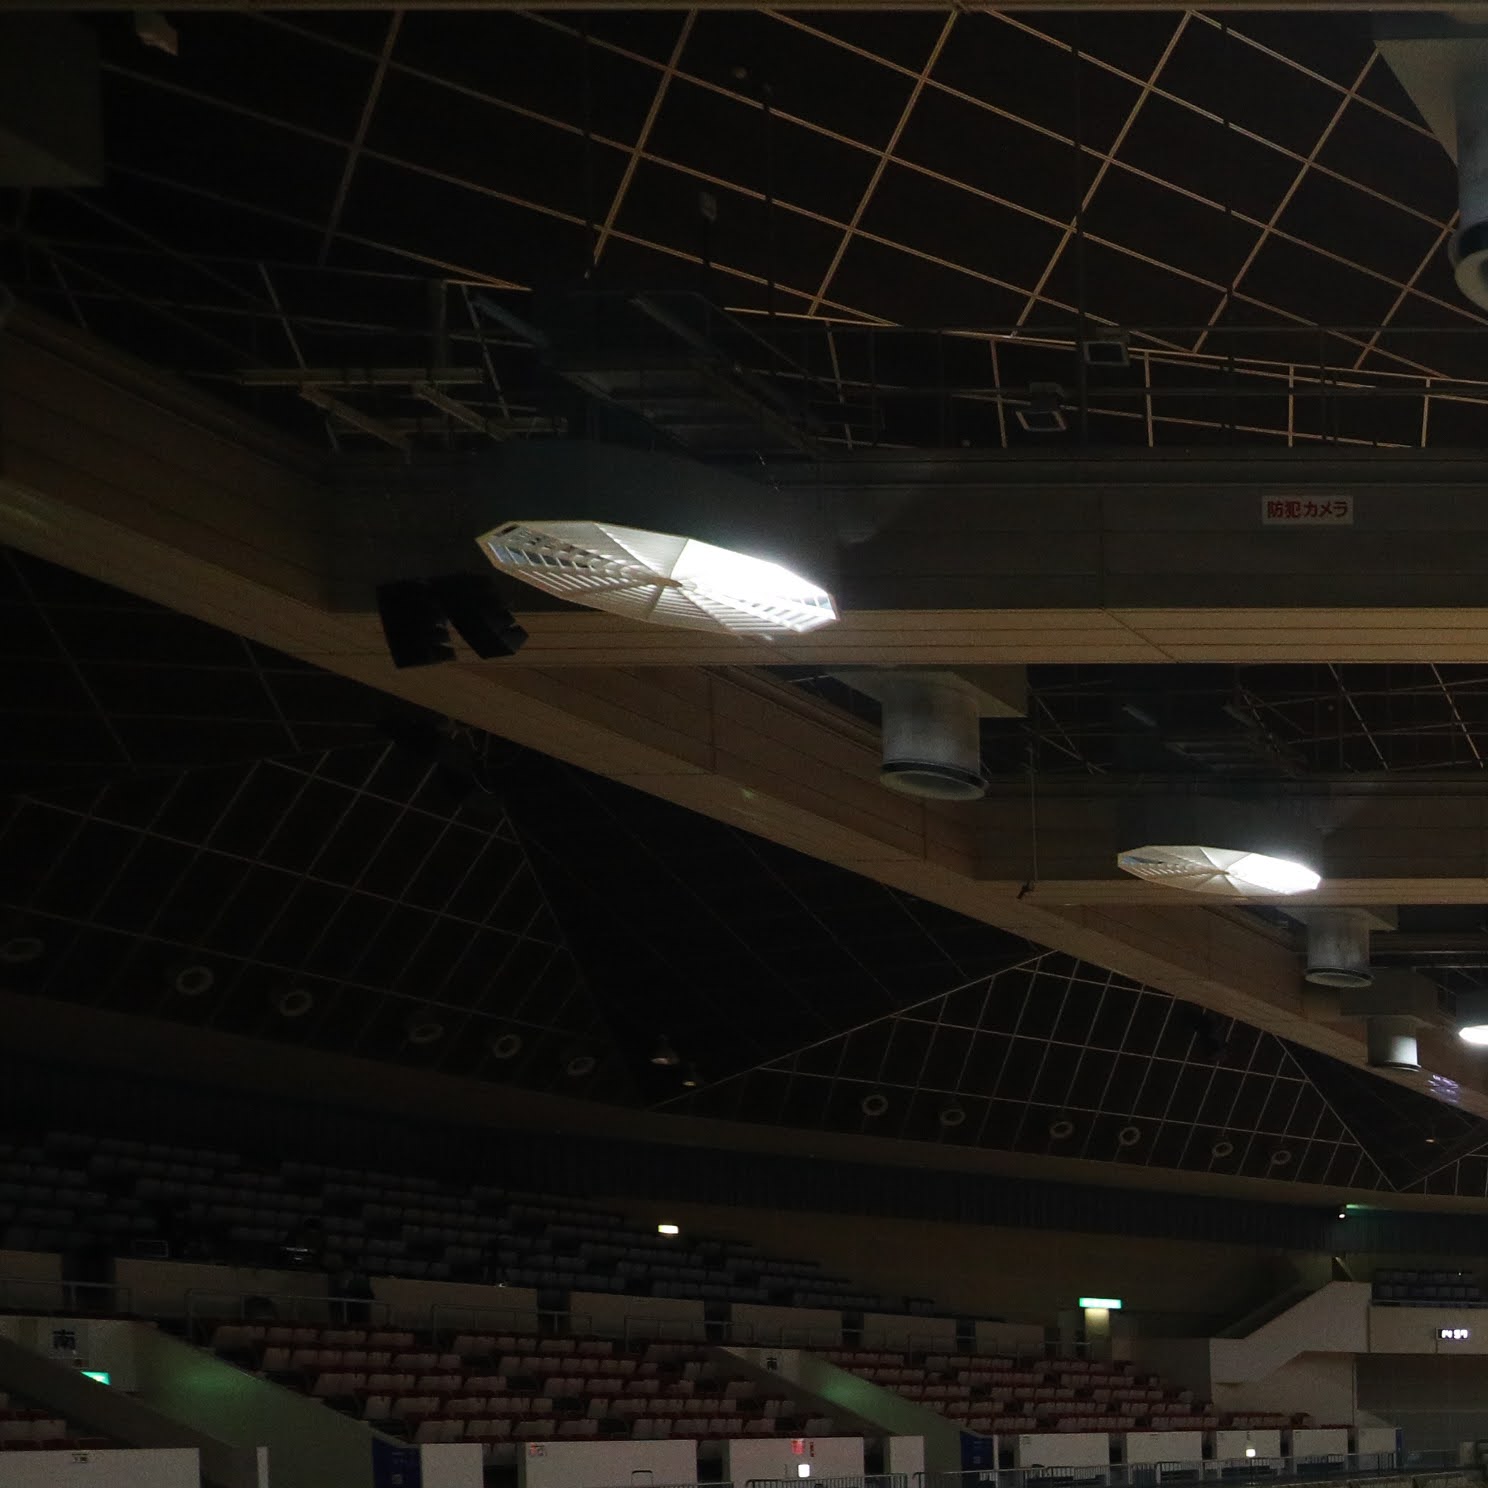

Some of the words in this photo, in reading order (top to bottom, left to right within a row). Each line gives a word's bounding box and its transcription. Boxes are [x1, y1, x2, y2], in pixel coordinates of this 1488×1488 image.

[1267, 501, 1348, 518] 防犯カメラ
